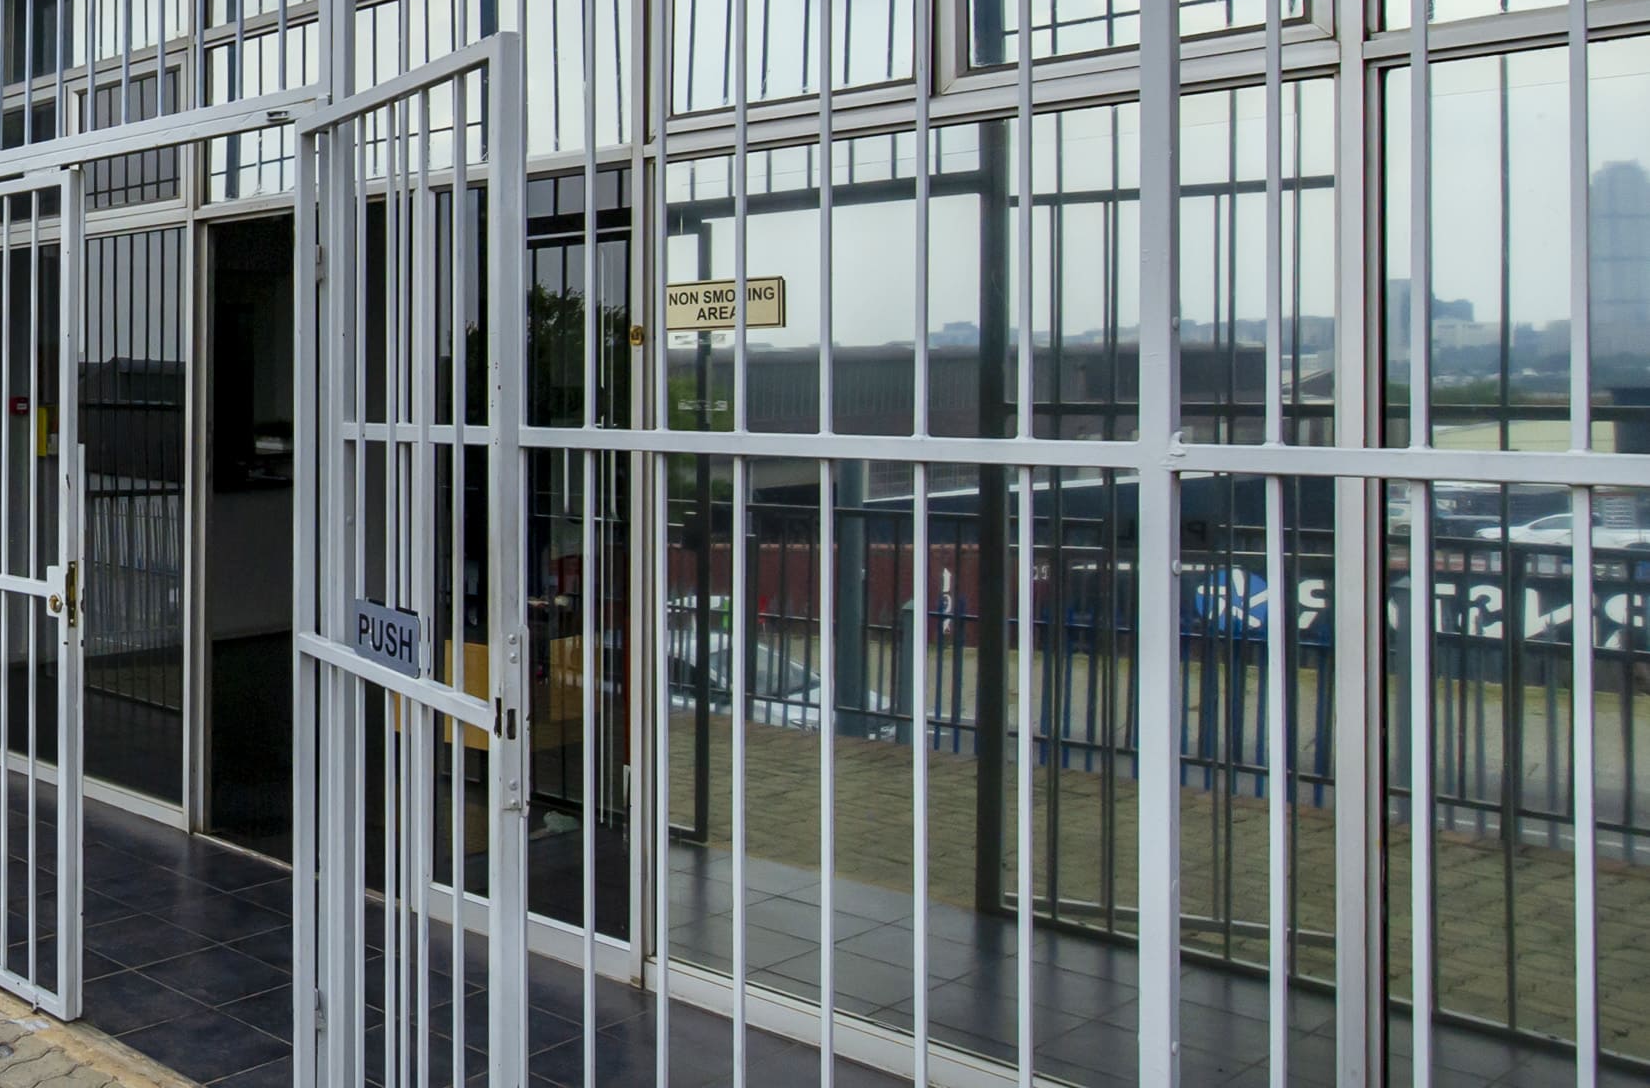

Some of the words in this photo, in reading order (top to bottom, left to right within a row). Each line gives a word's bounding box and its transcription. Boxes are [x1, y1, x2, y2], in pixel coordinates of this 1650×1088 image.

[669, 291, 699, 306] NON
[703, 286, 775, 304] SMOING
[358, 613, 413, 663] PUSH
